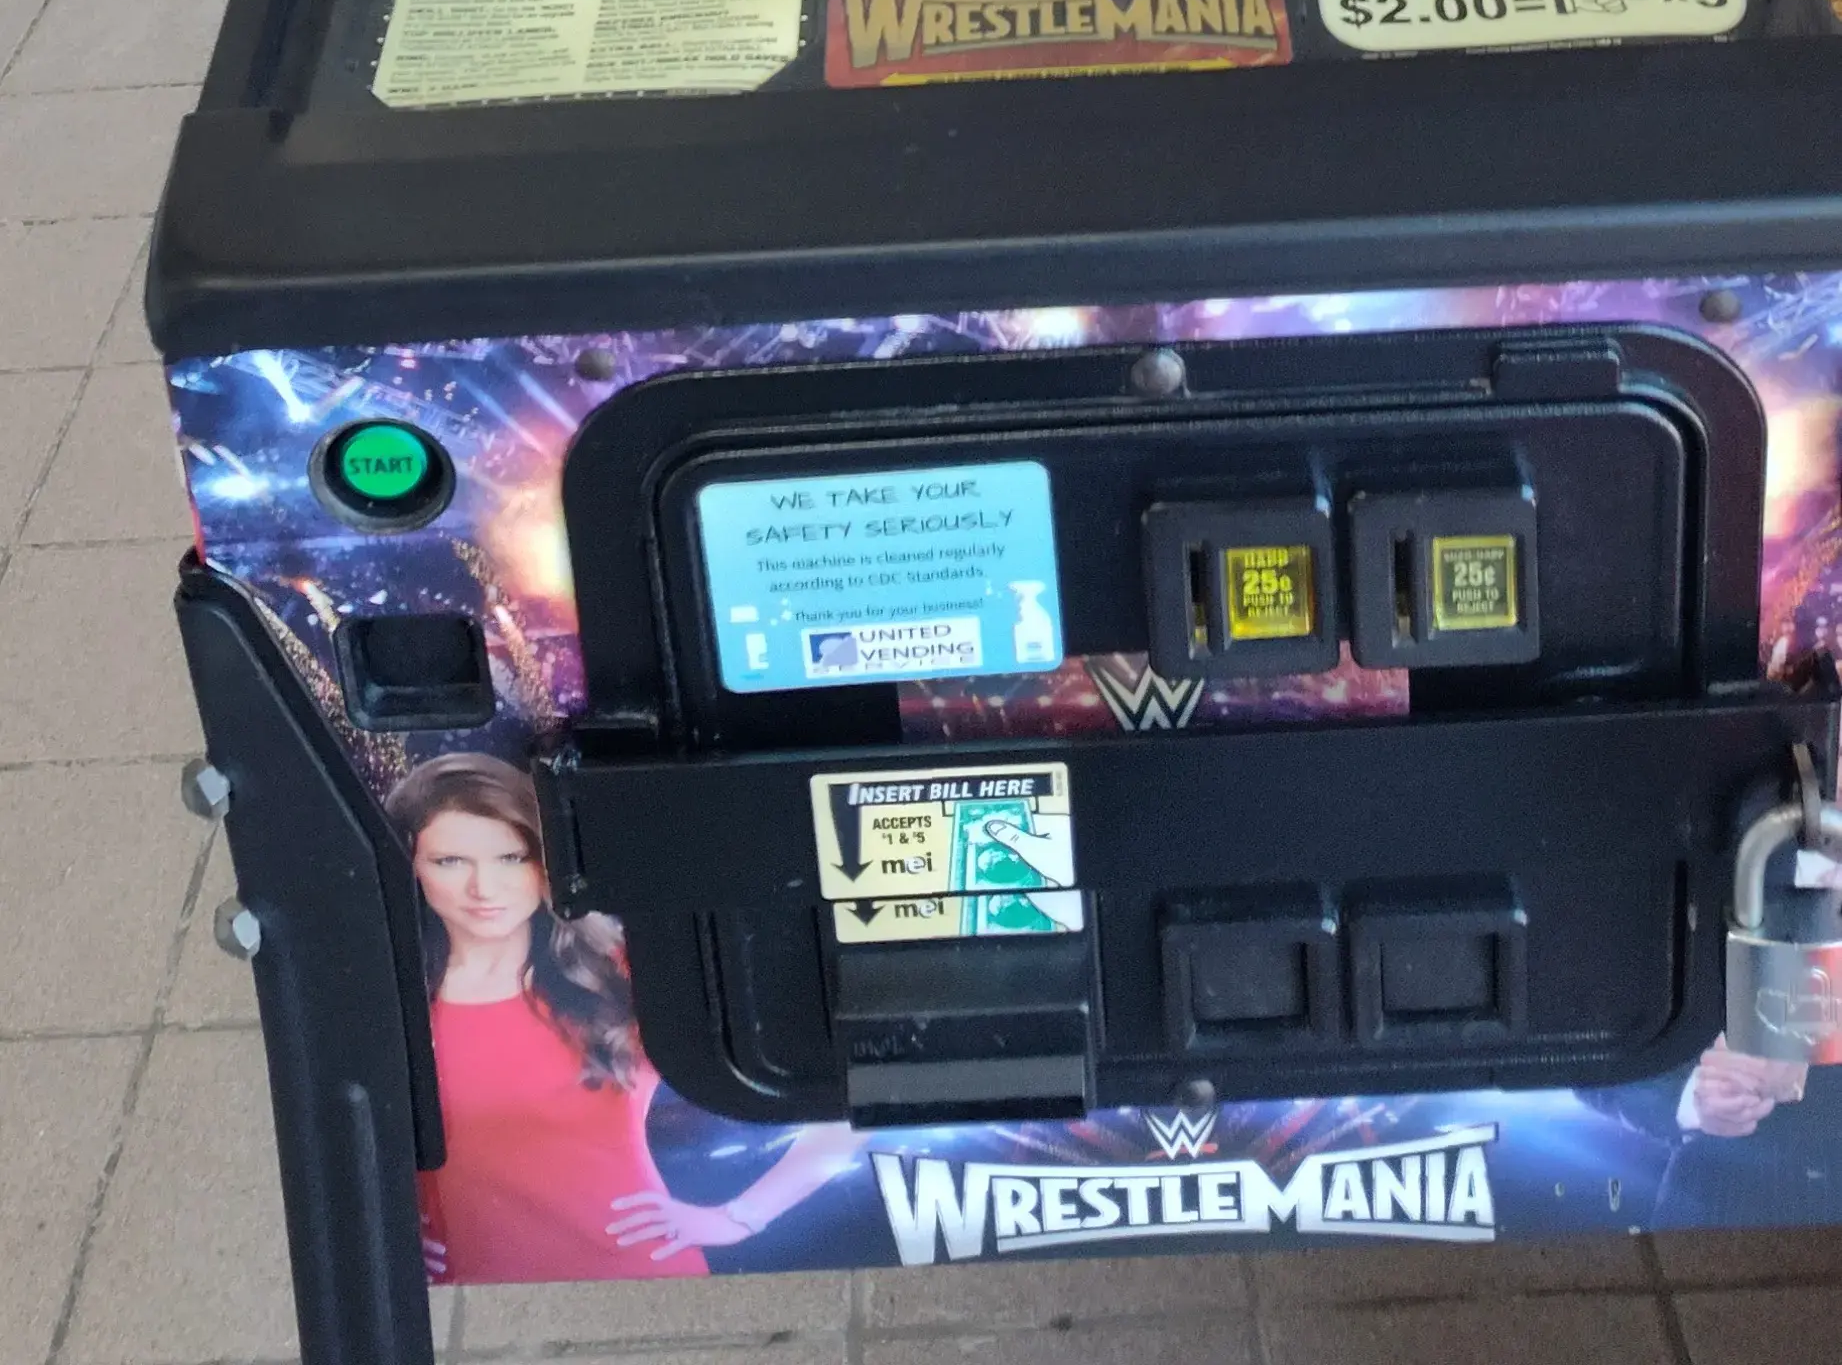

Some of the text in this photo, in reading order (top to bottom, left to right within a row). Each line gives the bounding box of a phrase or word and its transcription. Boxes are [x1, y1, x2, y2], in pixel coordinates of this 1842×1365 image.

[348, 456, 413, 475] START
[771, 480, 981, 510] WE TAKE YOUR
[746, 509, 1014, 546] SAFETY SERIOUSLY
[756, 542, 1006, 572] This machine is cleaned regularly
[769, 573, 844, 594] according
[848, 574, 864, 588] to
[867, 571, 902, 586] CDC
[1453, 561, 1496, 587] 25¢
[1243, 593, 1293, 607] PUSH TO
[1452, 587, 1500, 601] PUSH TO
[795, 608, 834, 623] Thank
[838, 608, 863, 623] you
[866, 605, 885, 619] for
[889, 604, 919, 621] your
[1456, 601, 1496, 614] REJECT
[858, 624, 953, 644] UNITED
[860, 642, 975, 662] VENDING
[848, 781, 924, 805] INSERT
[929, 780, 973, 800] BILL
[979, 778, 1035, 797] HERE
[872, 815, 932, 830] ACCEPTS
[899, 832, 910, 844] &
[869, 1122, 1499, 1268] WRESTLEMANIA
